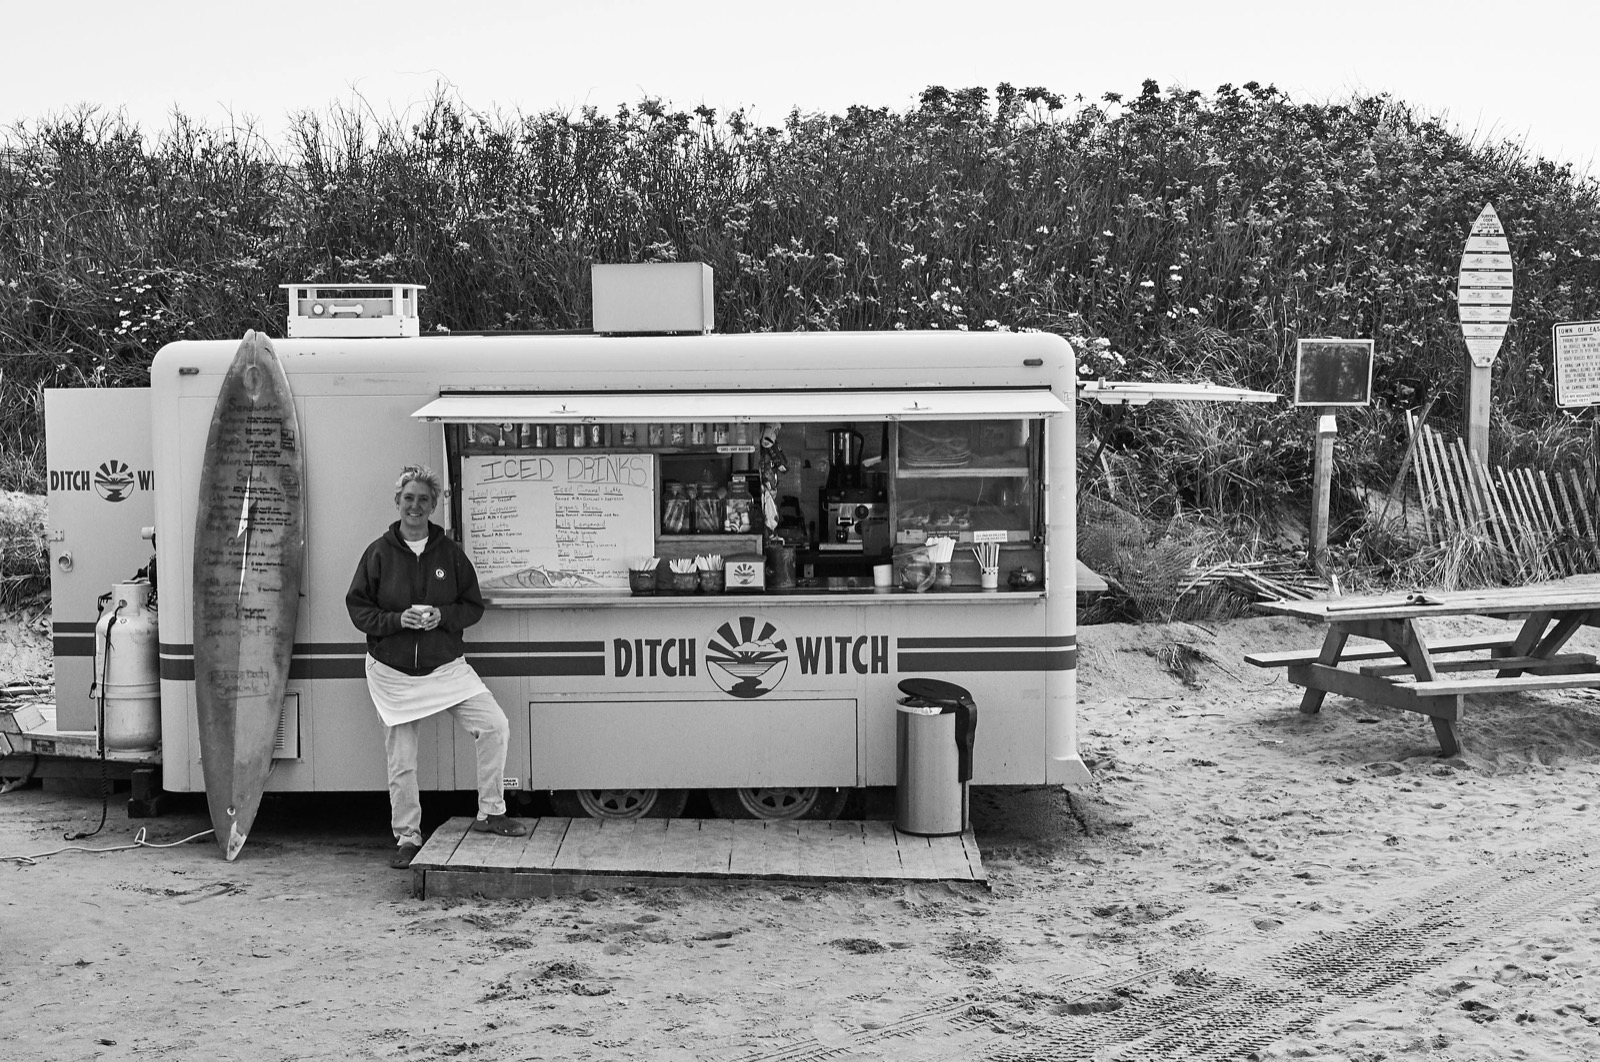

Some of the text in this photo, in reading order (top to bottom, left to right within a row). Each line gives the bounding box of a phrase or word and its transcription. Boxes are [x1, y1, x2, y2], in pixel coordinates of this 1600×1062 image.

[50, 470, 91, 491] DITCH
[481, 457, 648, 486] ICED DRINKS
[613, 635, 889, 677] DITCH WITCH
